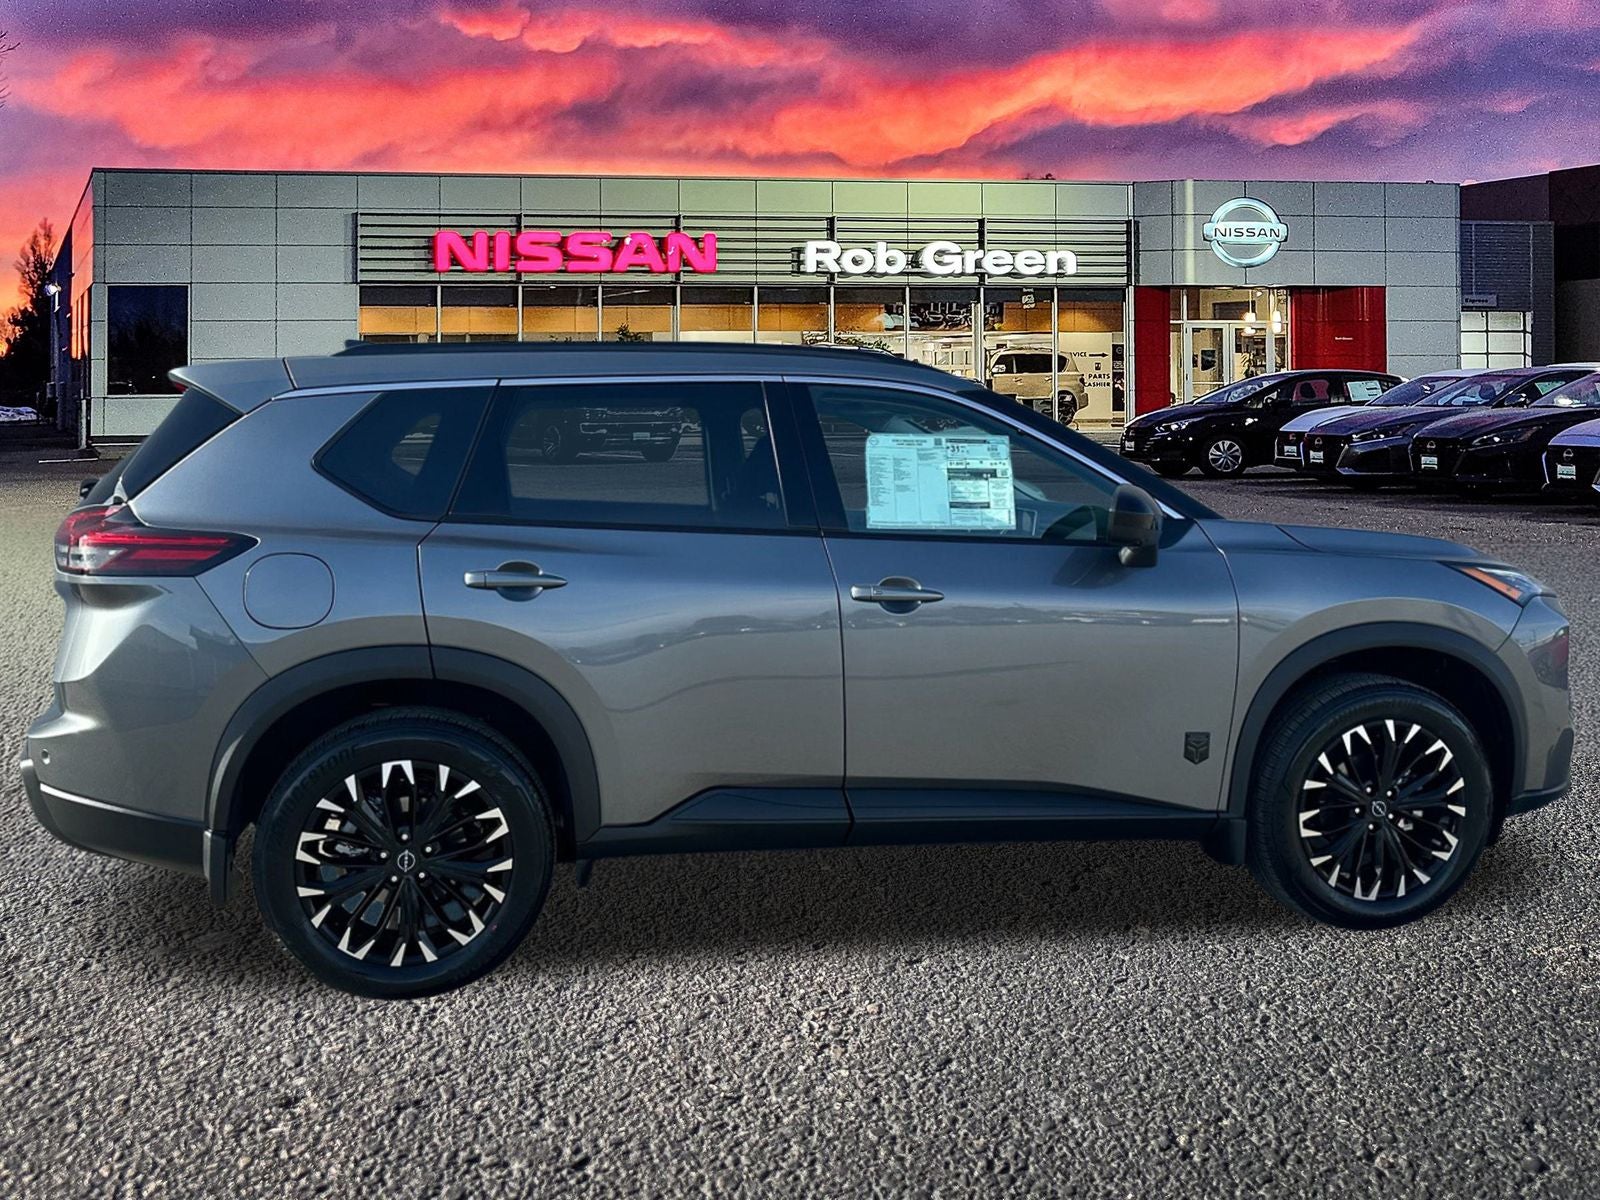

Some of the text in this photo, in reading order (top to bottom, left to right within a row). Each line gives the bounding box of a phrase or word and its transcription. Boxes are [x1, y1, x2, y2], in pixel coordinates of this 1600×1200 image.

[1214, 227, 1280, 238] NISSAN
[433, 230, 717, 273] NISSAN
[805, 240, 1078, 275] Rob Green
